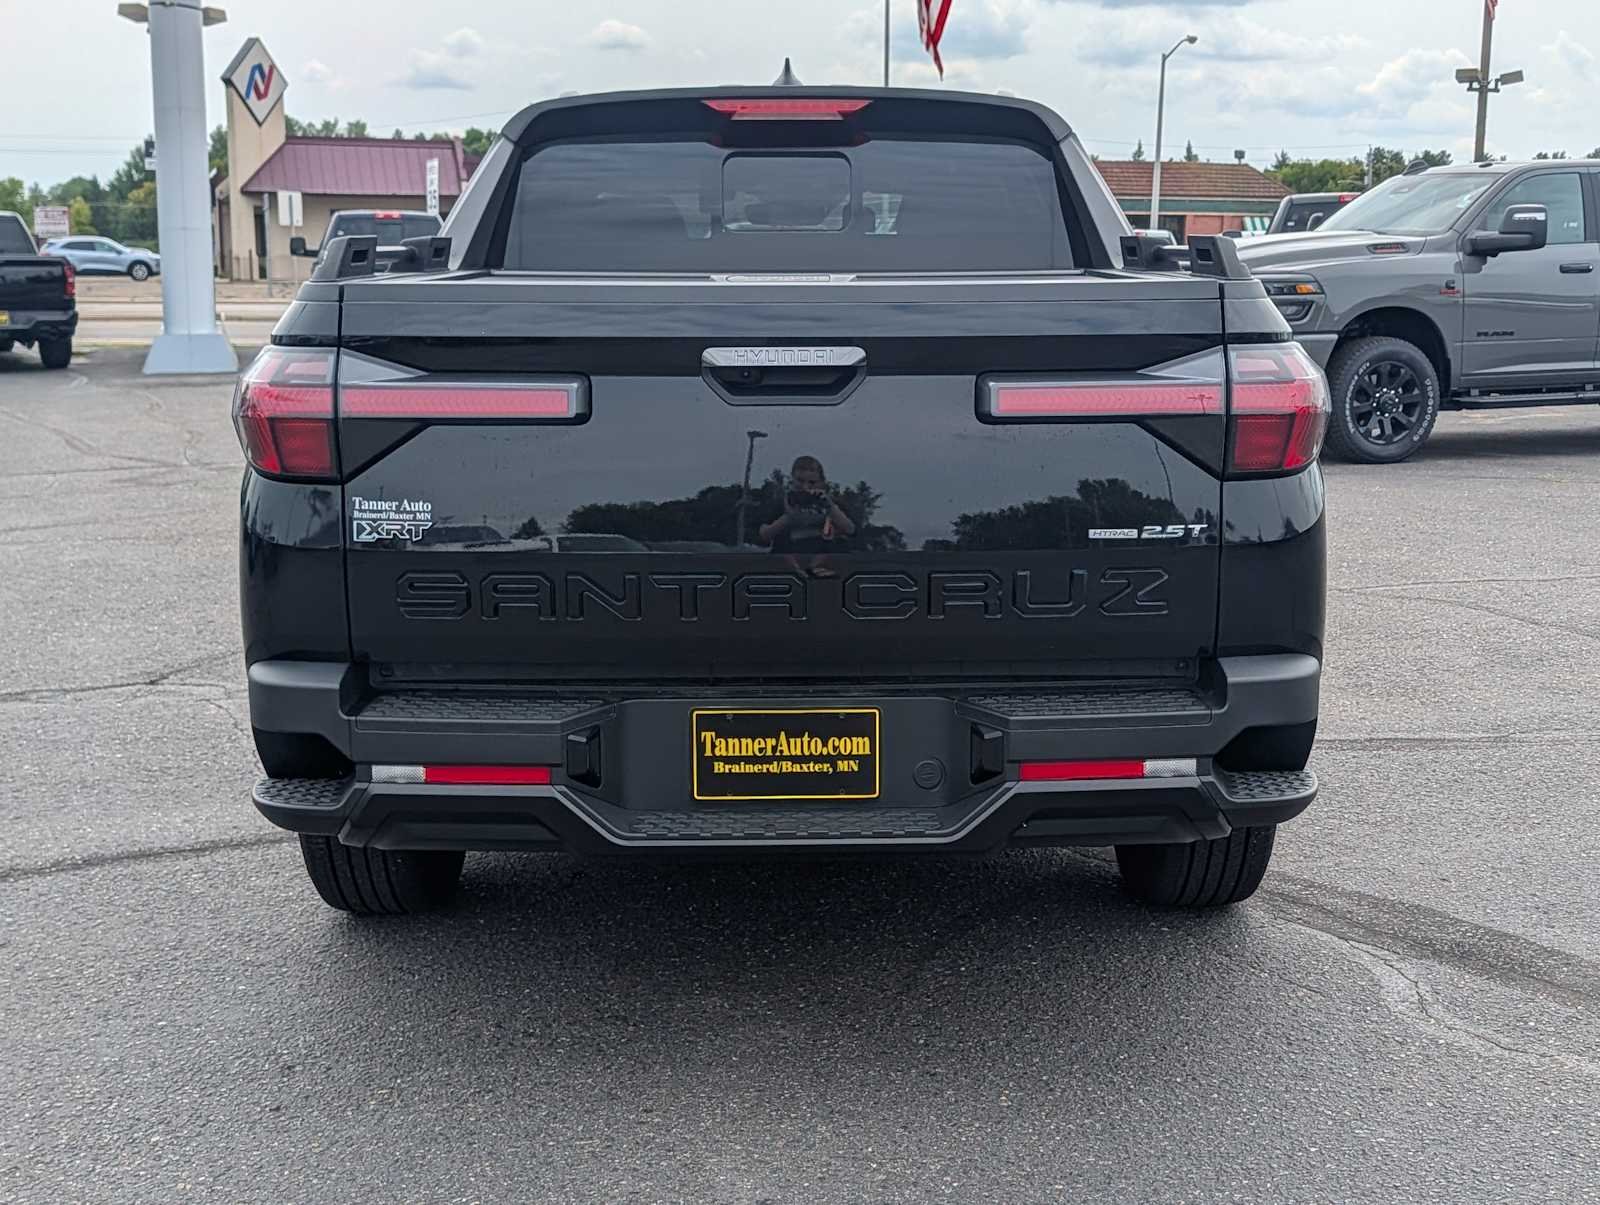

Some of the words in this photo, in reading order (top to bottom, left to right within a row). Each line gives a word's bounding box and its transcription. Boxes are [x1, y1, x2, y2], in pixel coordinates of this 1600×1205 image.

[733, 349, 834, 365] HYUNDAI
[352, 497, 399, 510] Tanner
[400, 499, 432, 512] Auto
[353, 510, 414, 520] Brainerd/Baxter
[416, 512, 432, 520] MN
[353, 520, 432, 542] XRT
[1091, 529, 1137, 539] HTRAC
[397, 573, 808, 622] SANTA
[842, 567, 1168, 620] CRUZ
[701, 730, 871, 757] TannerAuto.com
[713, 761, 834, 775] Brainerd/Baxter,
[836, 760, 860, 772] MN
